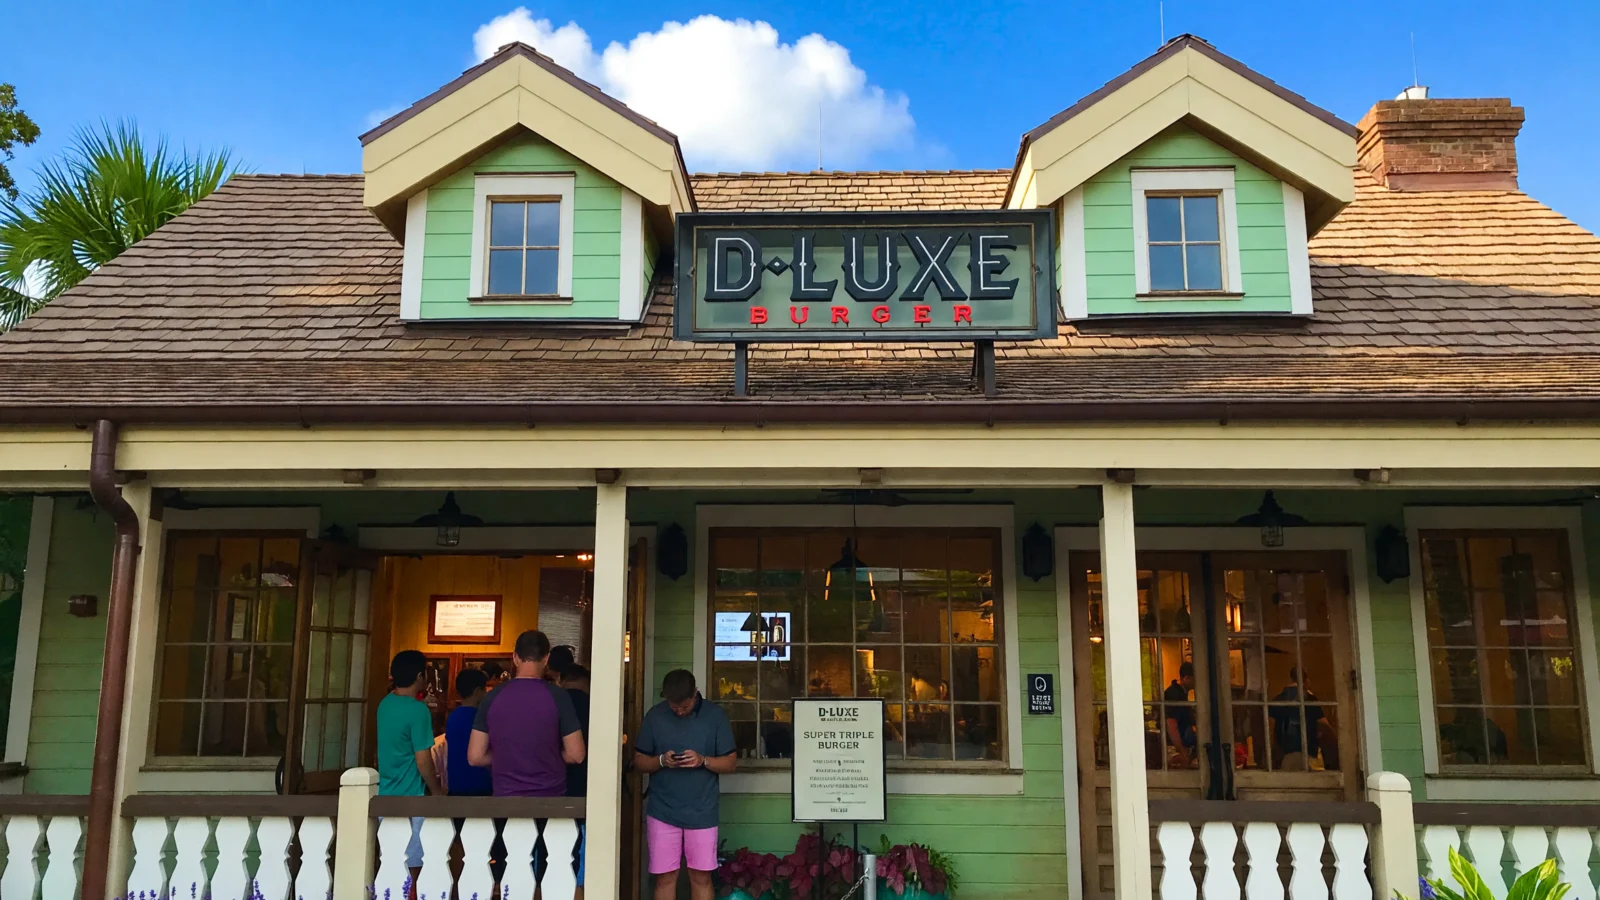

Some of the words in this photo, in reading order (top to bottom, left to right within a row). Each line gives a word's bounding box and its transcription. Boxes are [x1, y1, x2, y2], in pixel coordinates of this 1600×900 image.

[750, 305, 973, 325] BURGER
[803, 731, 836, 739] SUPER
[839, 731, 875, 739] TRIPLE
[818, 741, 860, 749] BURGER
